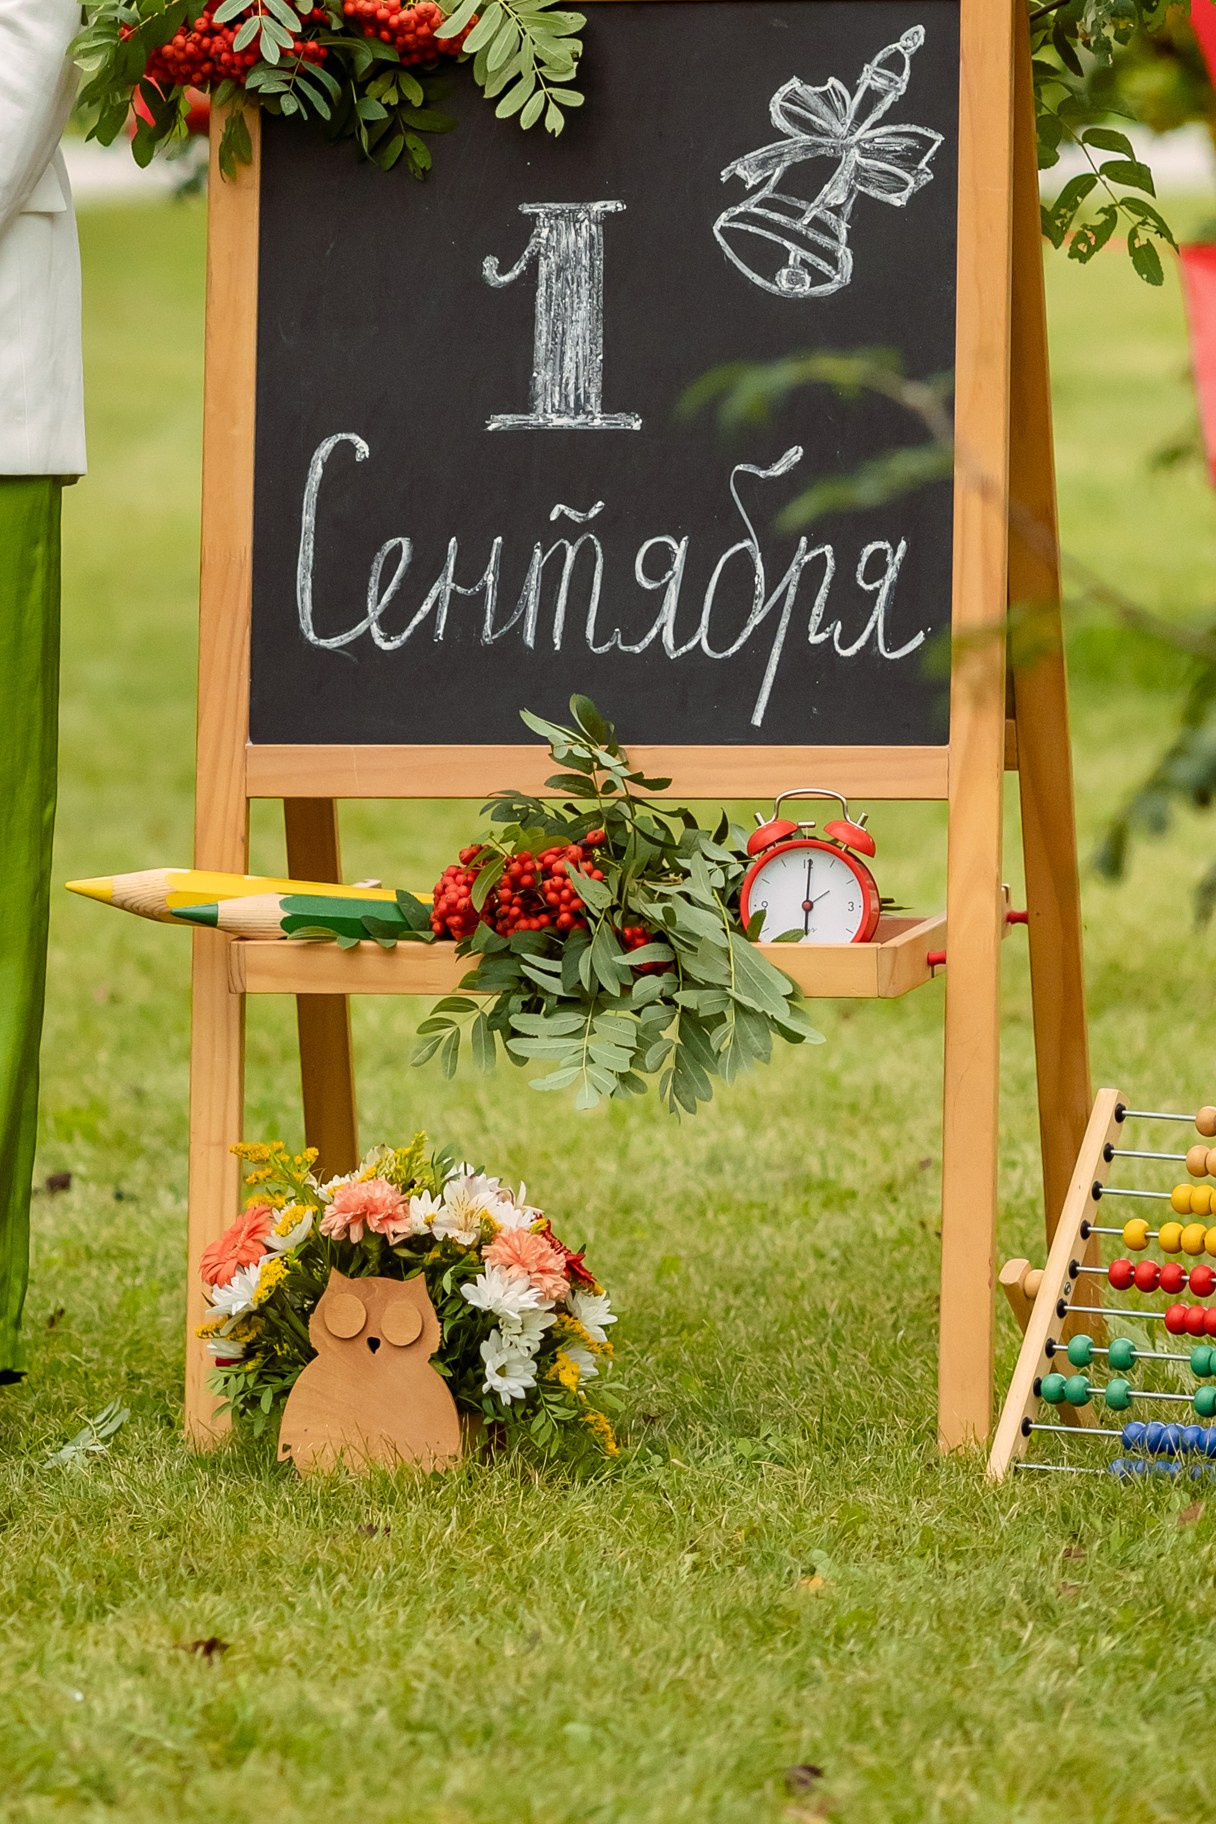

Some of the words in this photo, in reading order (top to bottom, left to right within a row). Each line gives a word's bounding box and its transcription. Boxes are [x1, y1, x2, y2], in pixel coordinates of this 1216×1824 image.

[482, 199, 643, 432] 1
[296, 432, 934, 728] Сентября
[847, 901, 855, 912] 3
